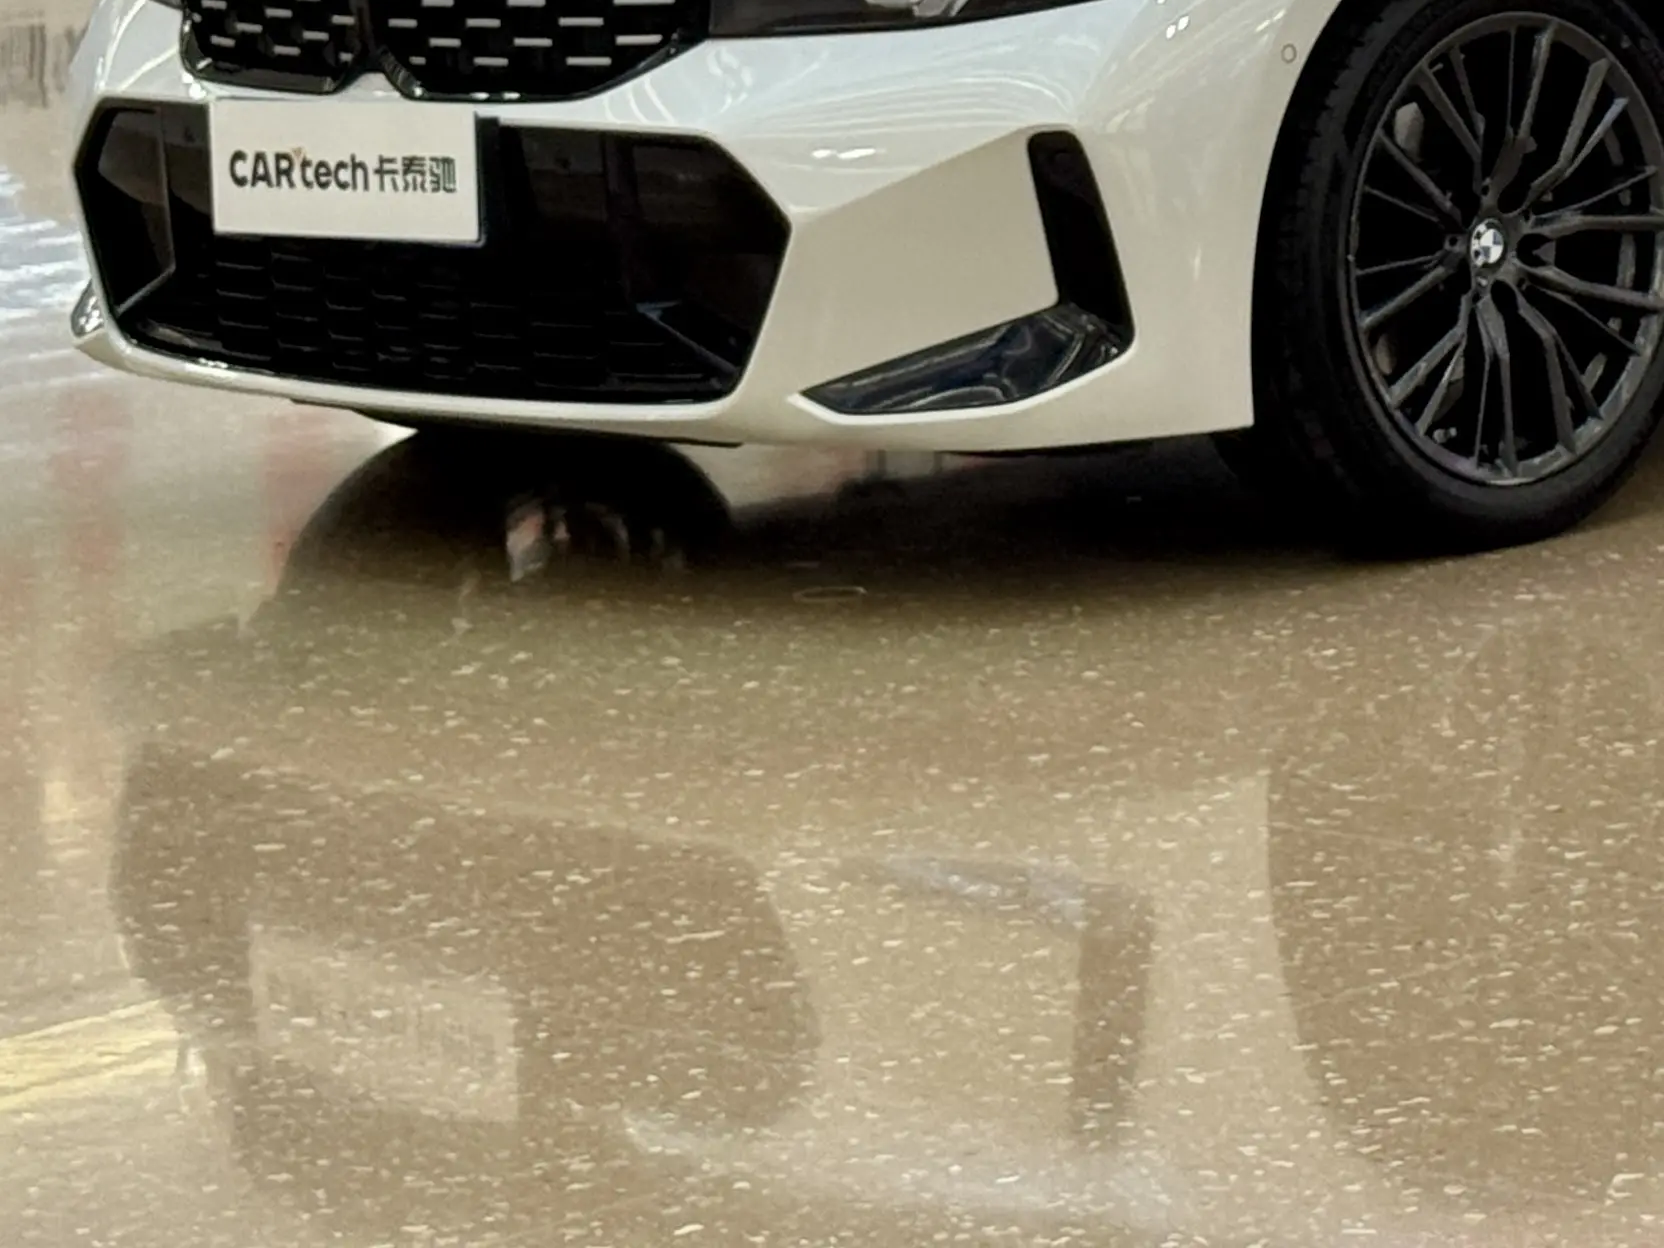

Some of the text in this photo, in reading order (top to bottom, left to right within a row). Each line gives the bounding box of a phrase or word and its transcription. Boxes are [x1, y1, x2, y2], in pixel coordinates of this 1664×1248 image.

[229, 149, 457, 194] CARtech 卡泰驰
